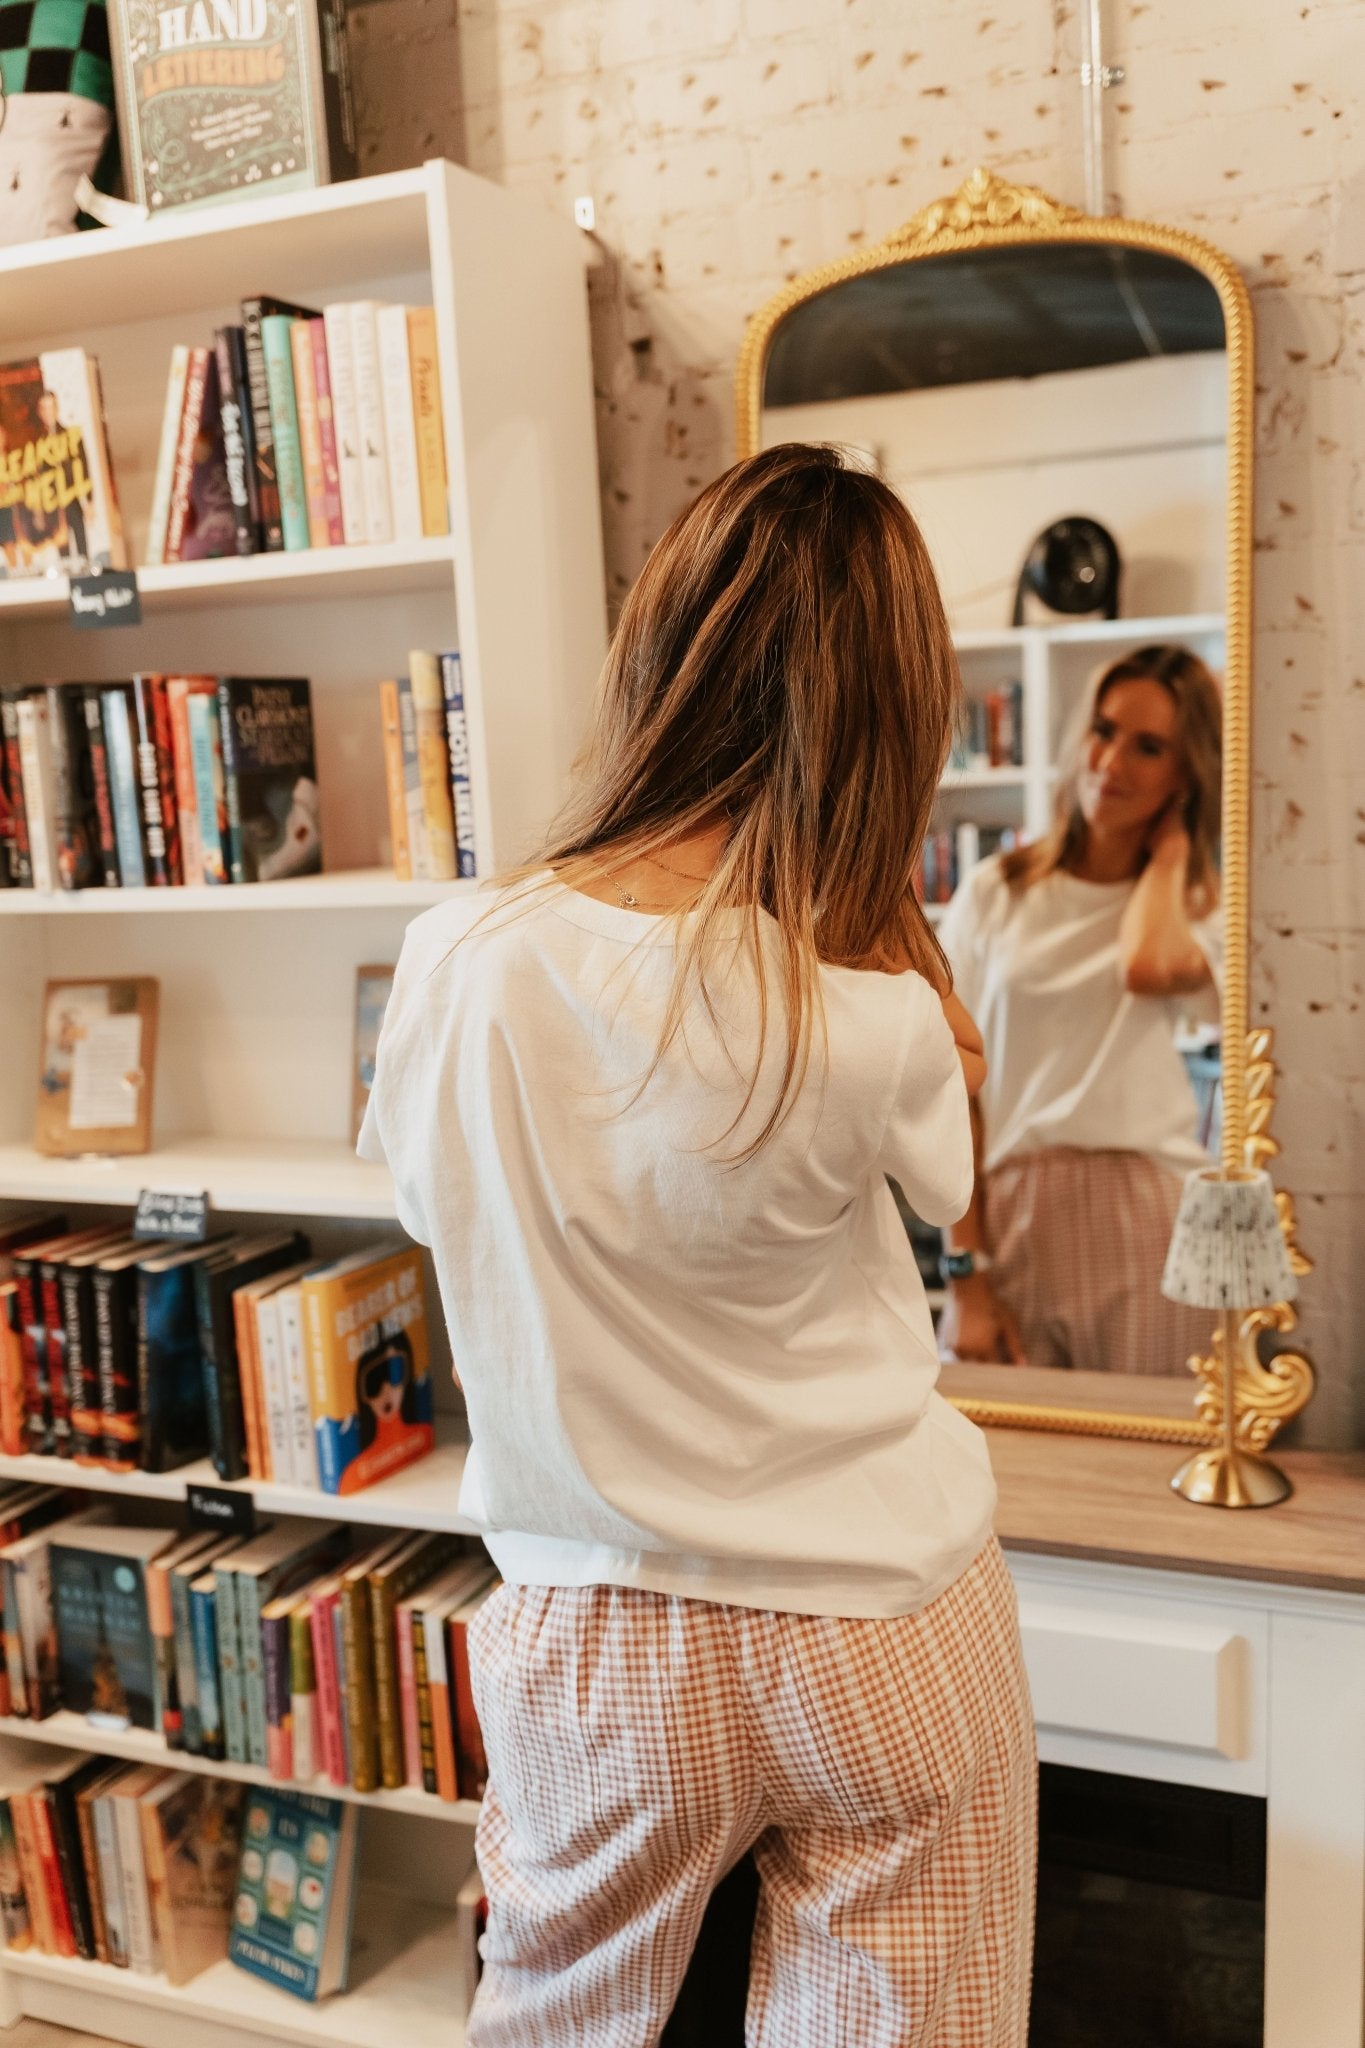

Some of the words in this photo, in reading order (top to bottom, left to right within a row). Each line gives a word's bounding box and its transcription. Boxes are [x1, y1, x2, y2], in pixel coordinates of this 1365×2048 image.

[158, 0, 268, 51] HAND
[143, 42, 286, 98] LETTERING
[24, 457, 93, 513] HELL
[446, 710, 469, 775] MOST
